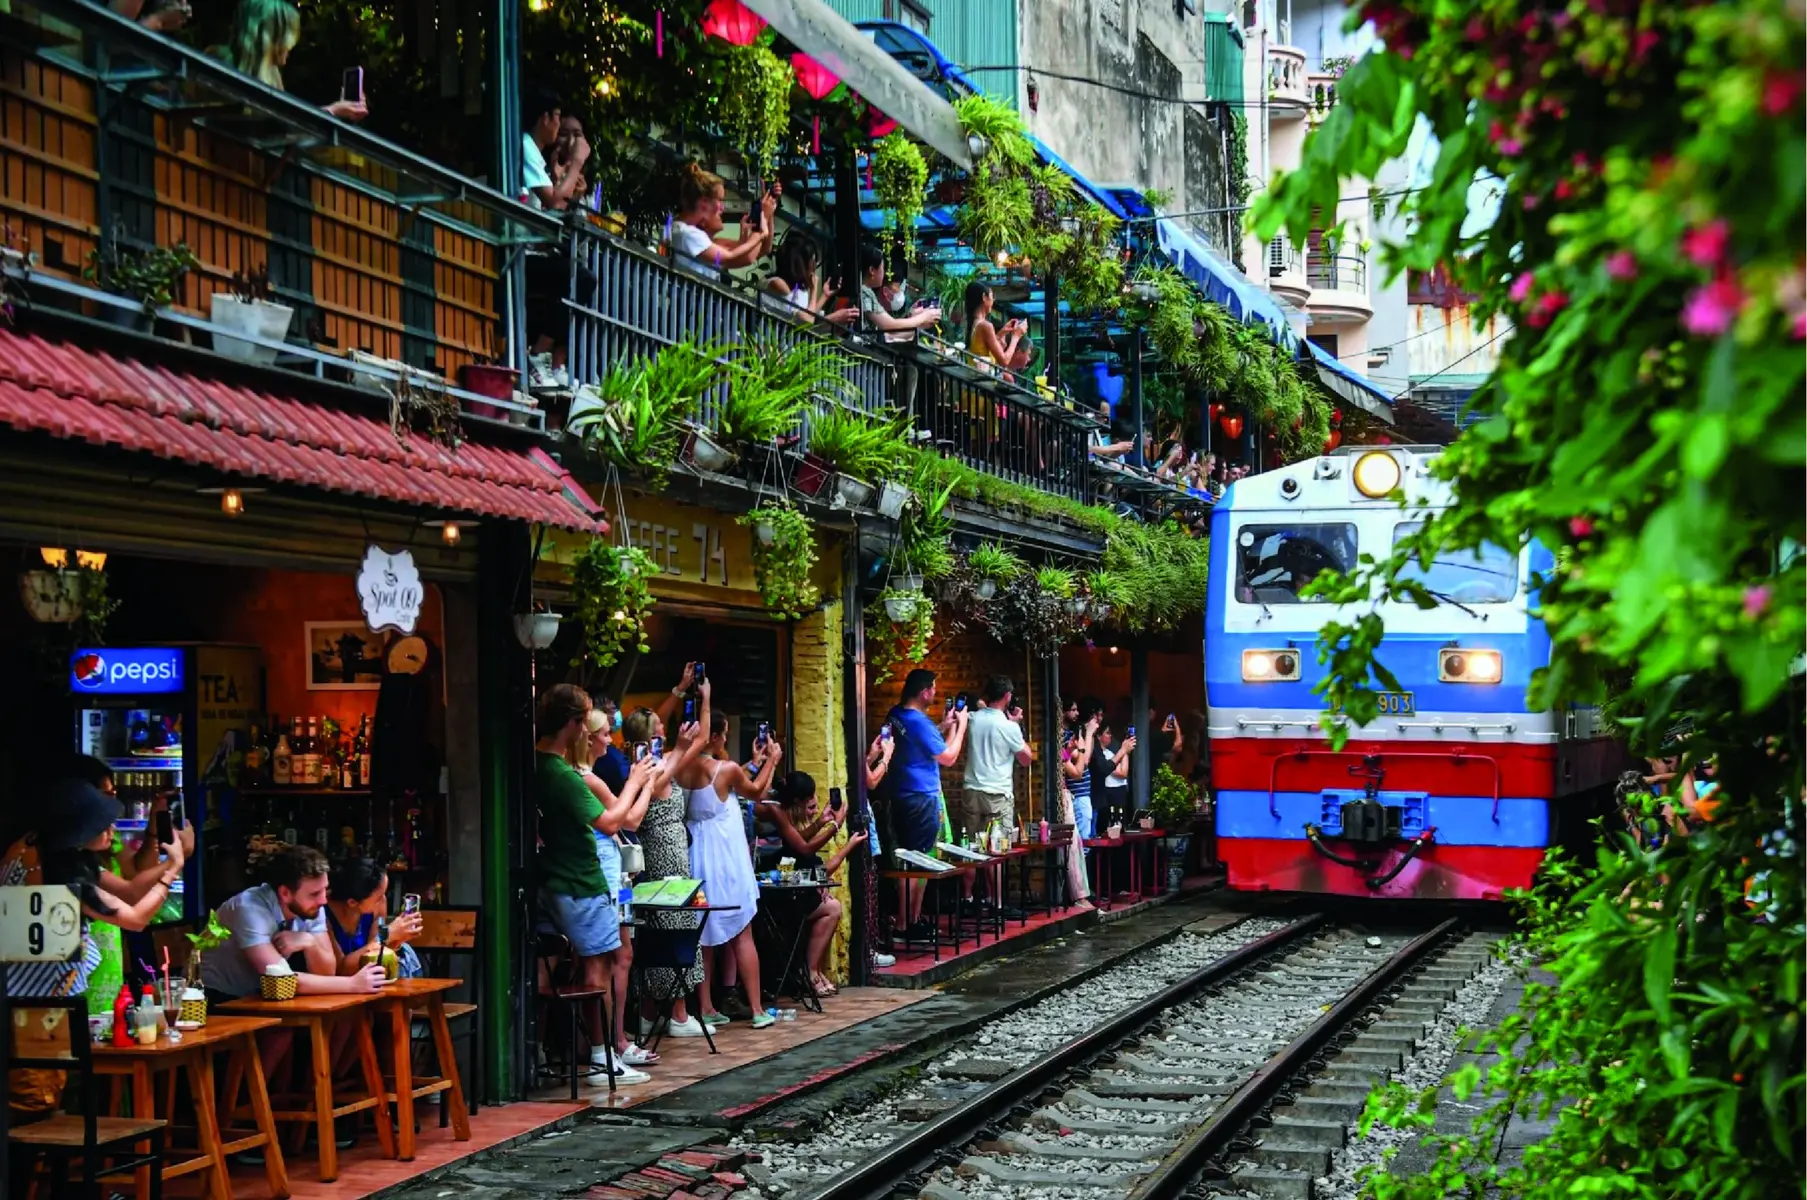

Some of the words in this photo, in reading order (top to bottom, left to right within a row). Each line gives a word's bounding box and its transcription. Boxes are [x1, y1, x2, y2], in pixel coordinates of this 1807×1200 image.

[693, 523, 728, 586] 74
[371, 583, 397, 613] Spot
[401, 587, 418, 611] 09
[110, 658, 176, 684] pepsi
[200, 675, 240, 703] TEA
